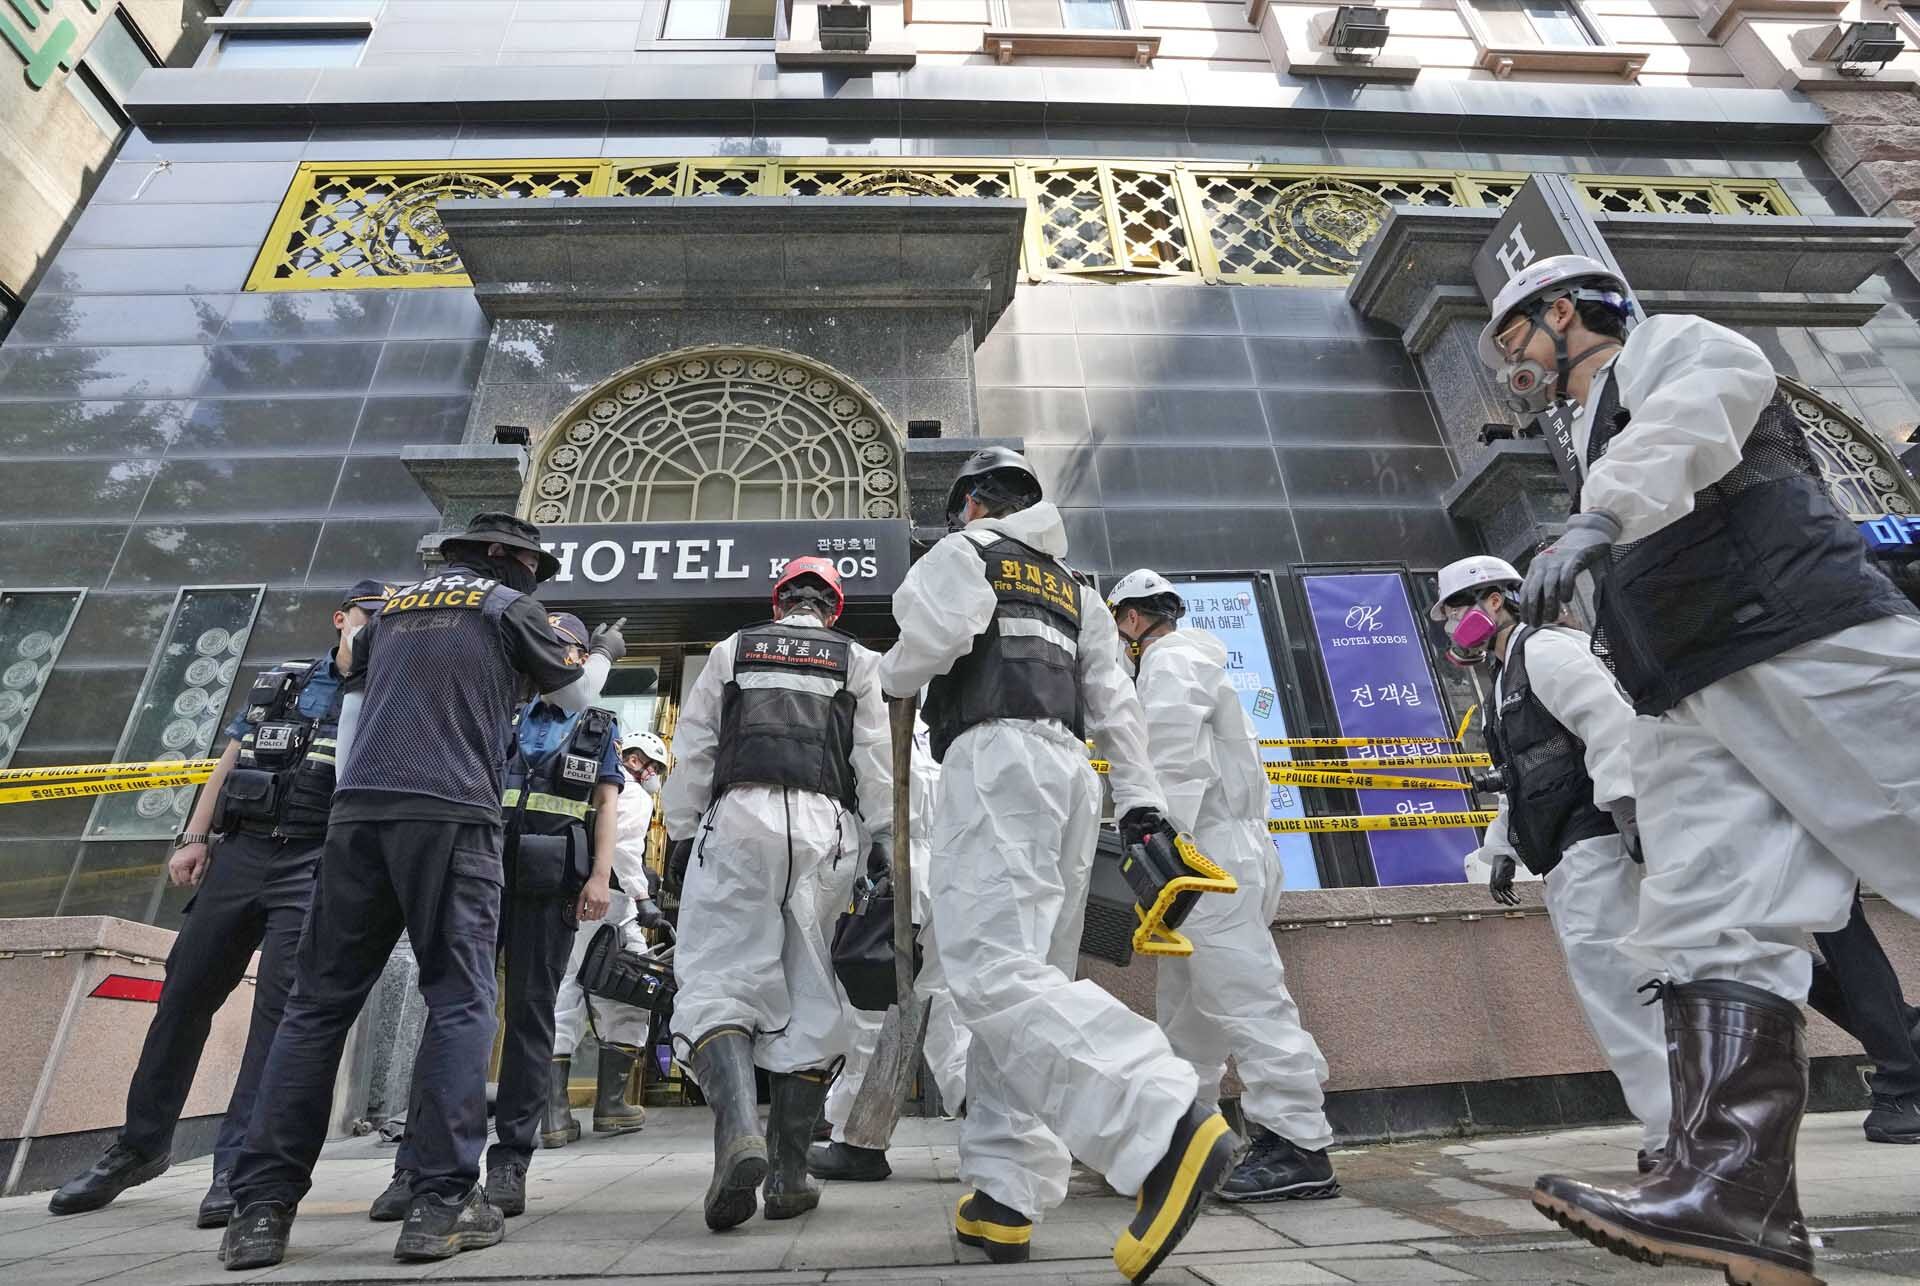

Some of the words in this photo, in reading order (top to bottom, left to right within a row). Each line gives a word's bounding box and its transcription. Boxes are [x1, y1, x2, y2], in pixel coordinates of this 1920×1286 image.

[1867, 514, 1920, 545] 마
[817, 537, 876, 551] 관광호텔
[540, 538, 749, 583] HOTEL
[769, 556, 878, 579] KOS
[994, 580, 1012, 590] Fire
[1015, 581, 1041, 594] Scene
[1001, 559, 1074, 604] 화재조사
[383, 590, 485, 614] POLICE
[777, 638, 811, 647] 경기도
[1332, 637, 1370, 647] HOTEL
[1372, 635, 1408, 645] KOBOS
[754, 642, 831, 660] 화재조사
[762, 653, 786, 661] Scene
[787, 656, 838, 667] Investigation
[1223, 651, 1244, 669] 간
[1351, 684, 1375, 707] 전
[1378, 683, 1421, 706] 객실
[567, 770, 593, 780] POLICE
[1268, 820, 1301, 831] POLICE
